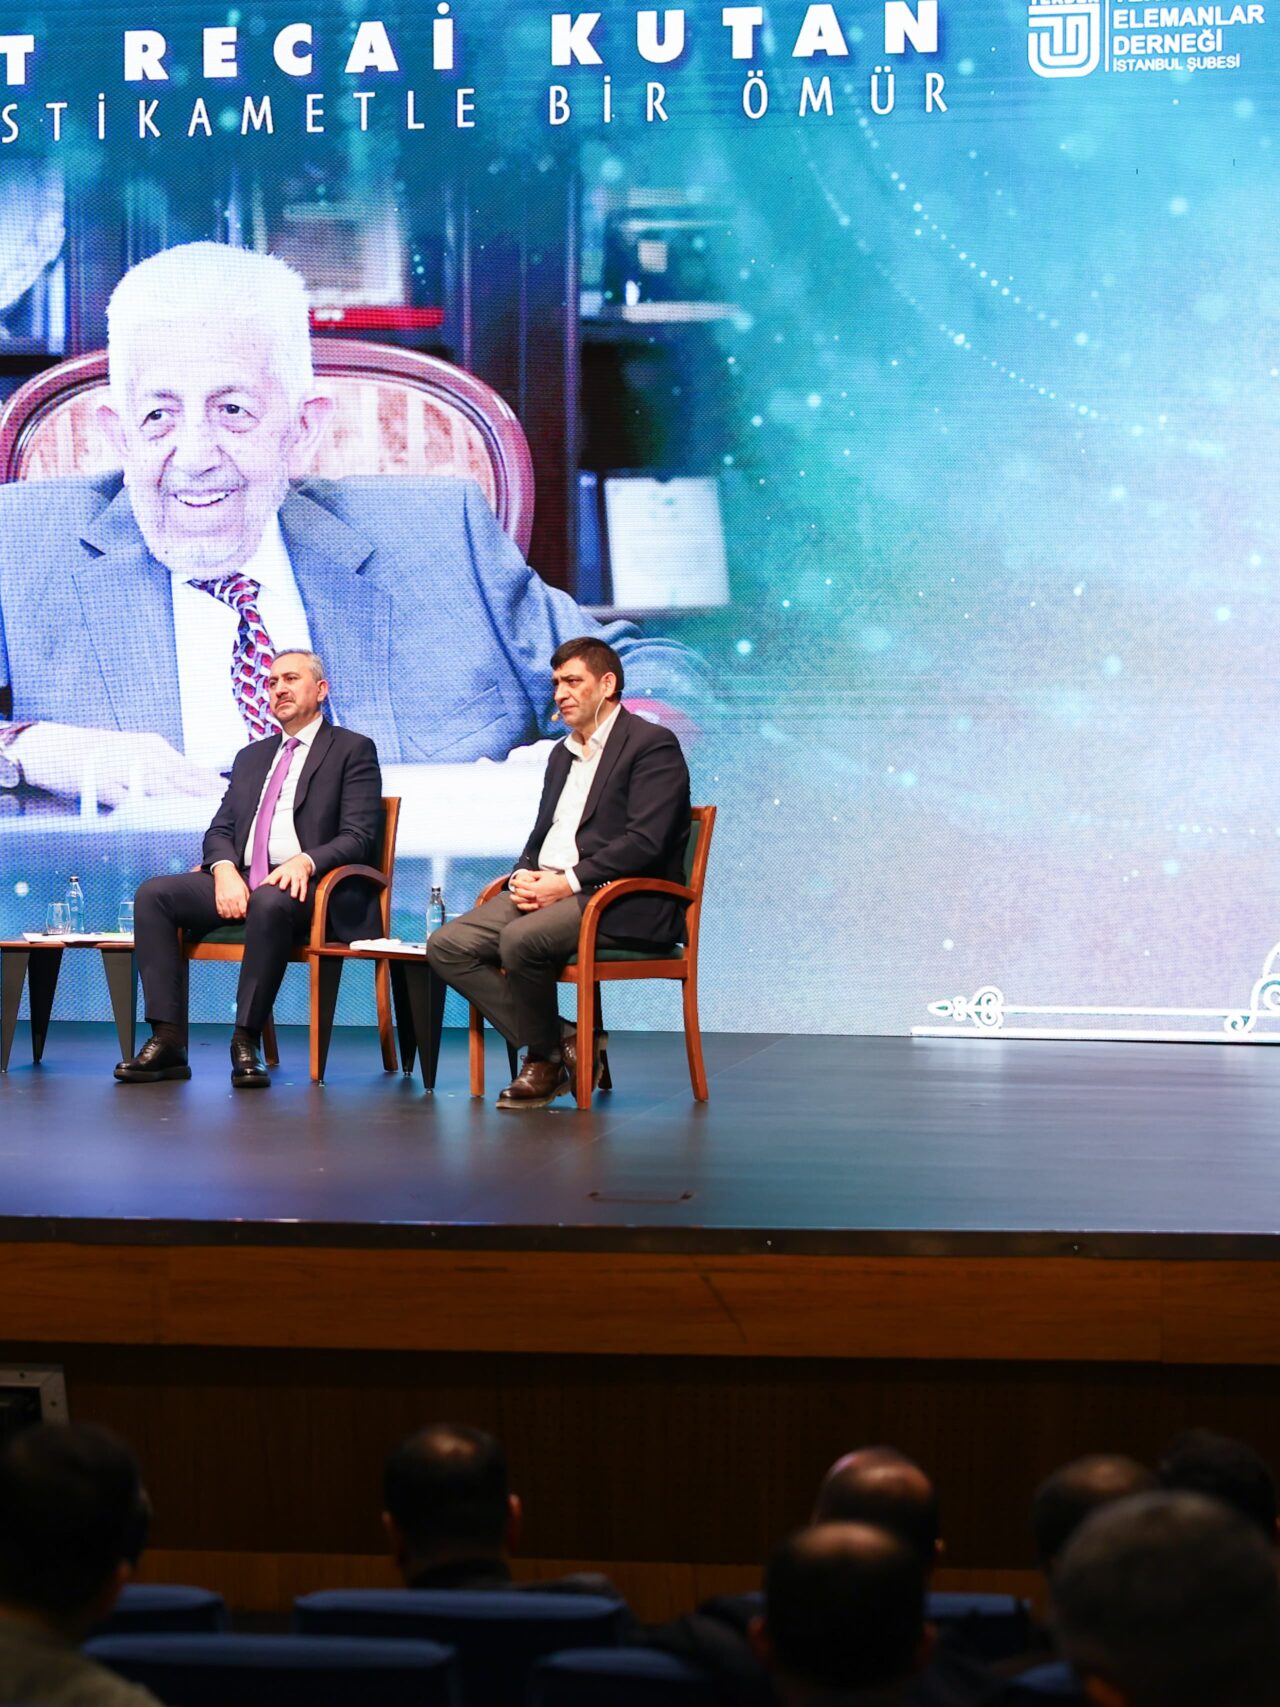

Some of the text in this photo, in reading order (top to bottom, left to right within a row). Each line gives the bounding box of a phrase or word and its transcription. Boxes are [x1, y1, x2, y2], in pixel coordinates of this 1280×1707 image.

[1113, 5, 1265, 29] ELEMANLAR
[123, 2, 453, 81] RECAİ
[551, 1, 938, 66] KUTAN
[1113, 28, 1223, 55] DERNEĞİ
[1113, 53, 1240, 73] İSTANBUL ŞUBESİ
[549, 75, 669, 125] BİR
[742, 66, 948, 119] ÖMÜR
